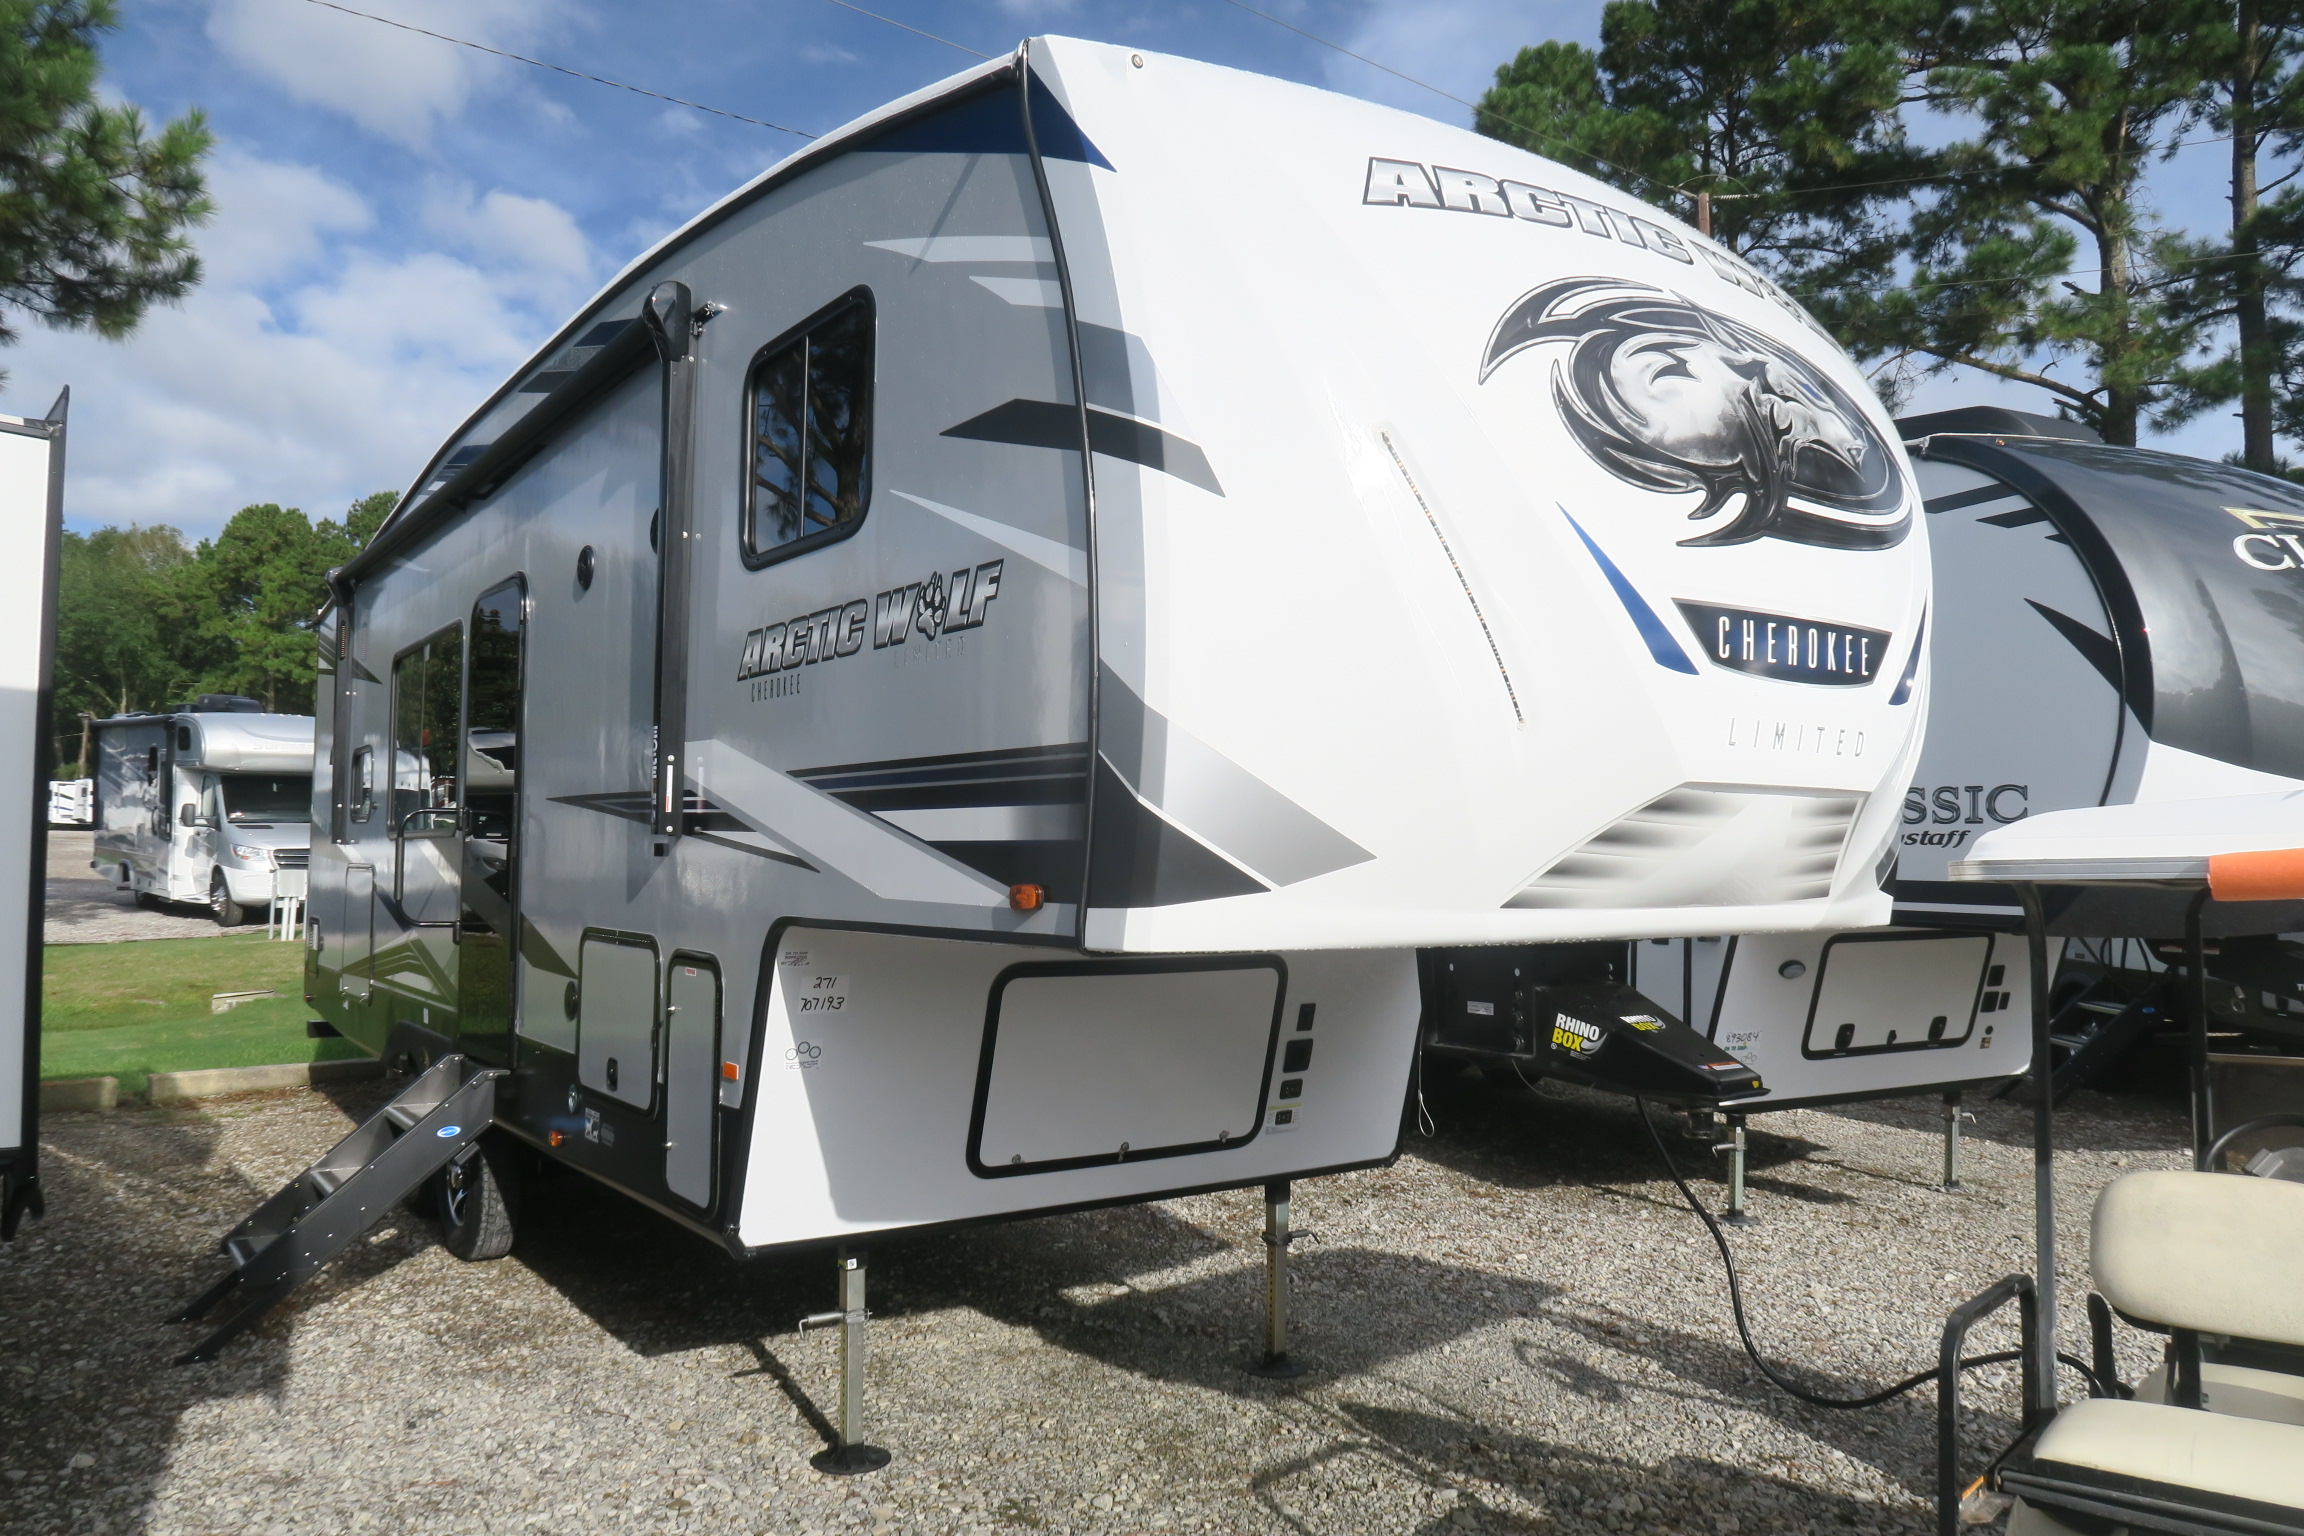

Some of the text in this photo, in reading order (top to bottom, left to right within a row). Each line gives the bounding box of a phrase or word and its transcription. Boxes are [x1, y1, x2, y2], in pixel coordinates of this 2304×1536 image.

[1362, 155, 1694, 265] ARCTIC
[737, 598, 868, 682] ARCTIC
[1718, 615, 1869, 676] CHEROKEE
[751, 673, 801, 703] CHEROKEE
[1728, 717, 1867, 757] LIMITED
[1901, 830, 1972, 849] staff
[813, 976, 837, 989] 271
[800, 996, 845, 1012] 707193
[1552, 1027, 1584, 1052] BOX
[1555, 1012, 1600, 1041] RHINO
